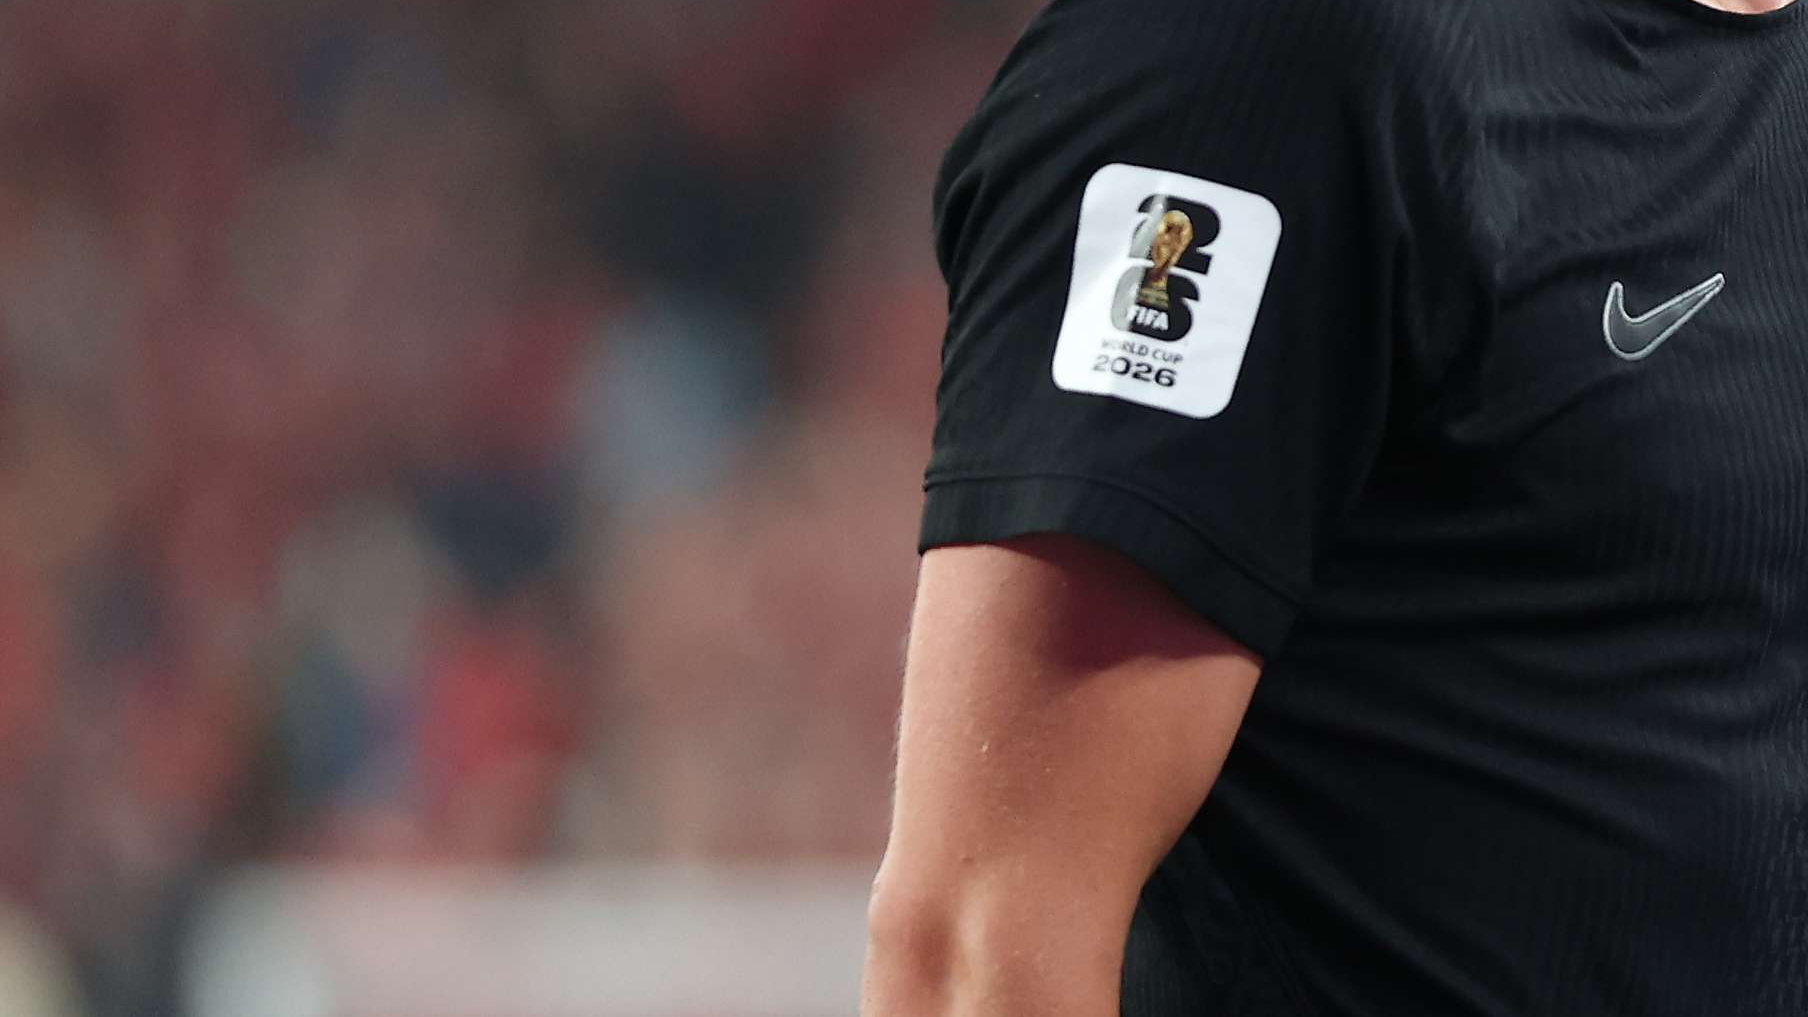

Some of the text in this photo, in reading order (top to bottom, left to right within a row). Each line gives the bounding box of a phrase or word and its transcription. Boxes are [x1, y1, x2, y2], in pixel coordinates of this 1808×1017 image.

[1125, 304, 1170, 332] FIFA
[1102, 338, 1184, 365] RLD CUP
[1092, 354, 1178, 388] 2026
